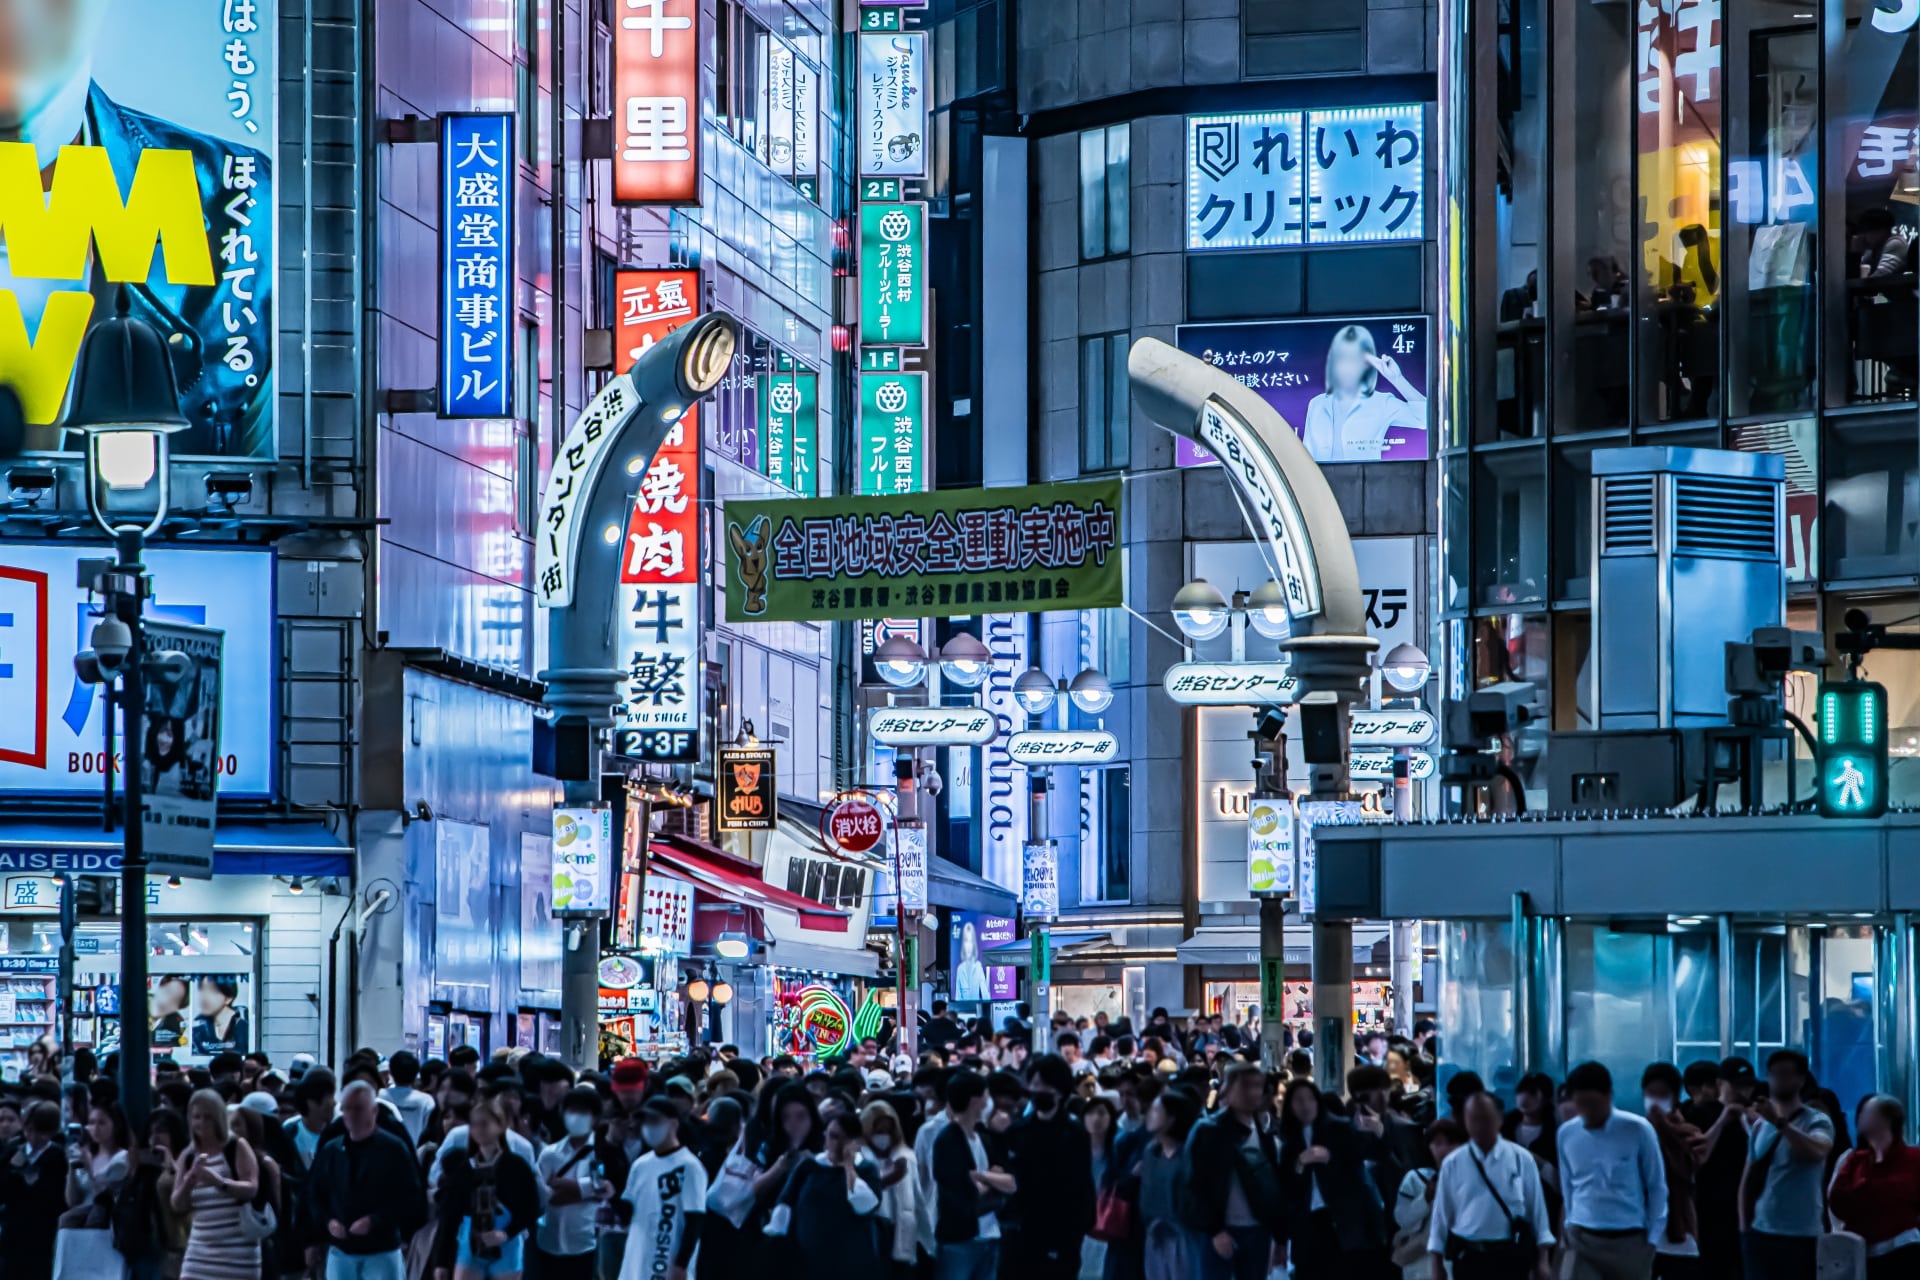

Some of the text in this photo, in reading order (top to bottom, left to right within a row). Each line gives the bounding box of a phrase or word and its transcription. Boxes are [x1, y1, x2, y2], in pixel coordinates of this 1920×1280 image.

[868, 12, 895, 27] 3F
[886, 56, 898, 110] ジャスミン
[891, 37, 914, 111] Jasmine
[872, 73, 884, 171] レディースクリニック
[1253, 120, 1419, 175] れいわ
[867, 182, 895, 198] 2F
[1196, 185, 1419, 241] クリニック
[456, 131, 499, 401] 大盛堂商事ビル
[878, 243, 892, 340] フルーツパーラー
[897, 244, 912, 302] 渋谷西村
[1392, 324, 1416, 333] 当ビル
[1392, 334, 1415, 354] 4F
[868, 352, 895, 368] 1F
[1212, 350, 1290, 366] あなたのクマ
[870, 436, 889, 497] フルー
[894, 416, 914, 493] 渋谷西村
[541, 388, 624, 600] 渋谷センター街
[1207, 412, 1304, 605] 渋谷センター街
[773, 501, 1115, 579] 全国地域安全運動実施中
[630, 589, 686, 706] 牛繁
[654, 713, 688, 723] SHIGE
[875, 718, 989, 733] 渋谷センター街
[1013, 739, 1113, 754] 渋谷センター街
[730, 796, 763, 815] HUB
[835, 816, 880, 838] 消火栓
[1250, 839, 1292, 852] Welcome
